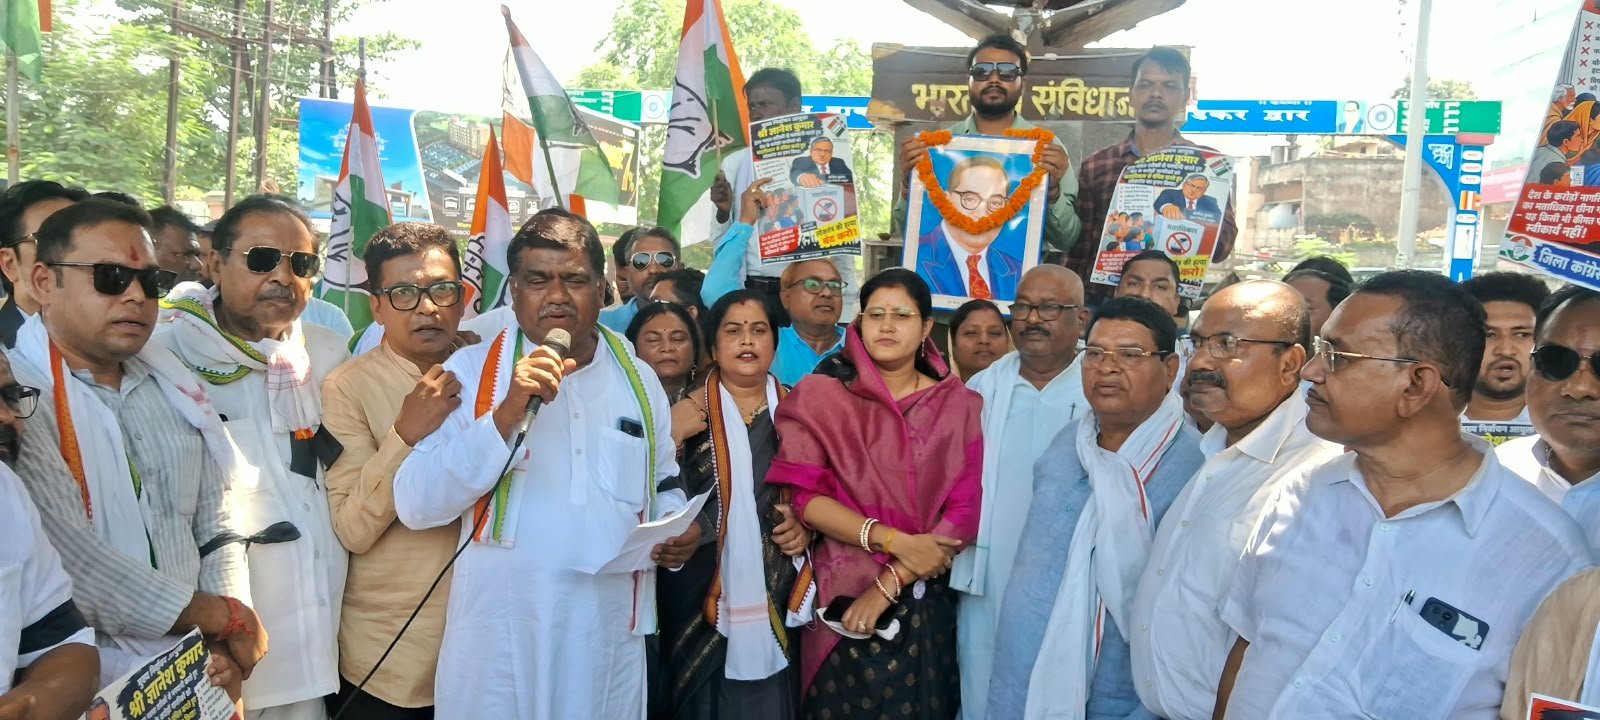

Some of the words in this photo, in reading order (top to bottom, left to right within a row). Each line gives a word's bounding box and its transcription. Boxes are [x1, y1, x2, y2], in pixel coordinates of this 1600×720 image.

[1031, 77, 1135, 117] संविधान
[793, 120, 815, 133] कुमार
[1174, 155, 1200, 165] कुमार
[1527, 189, 1542, 199] देश
[1543, 190, 1553, 199] के
[1554, 191, 1580, 202] करोड़ों
[1522, 201, 1534, 210] का
[1535, 201, 1574, 212] मताधिकार
[1576, 203, 1595, 213] छीना
[1525, 213, 1537, 221] यह
[1539, 211, 1560, 223] किसी
[1561, 213, 1572, 223] भी
[1573, 214, 1595, 225] कीमत
[1525, 222, 1563, 235] स्वीकार्य
[1562, 226, 1588, 238] नहीं!
[1538, 247, 1571, 270] जिला
[1180, 265, 1204, 277] करो!
[128, 689, 146, 719] श्री
[143, 664, 176, 705] ज्ञानेश
[174, 640, 204, 680] कुमार
